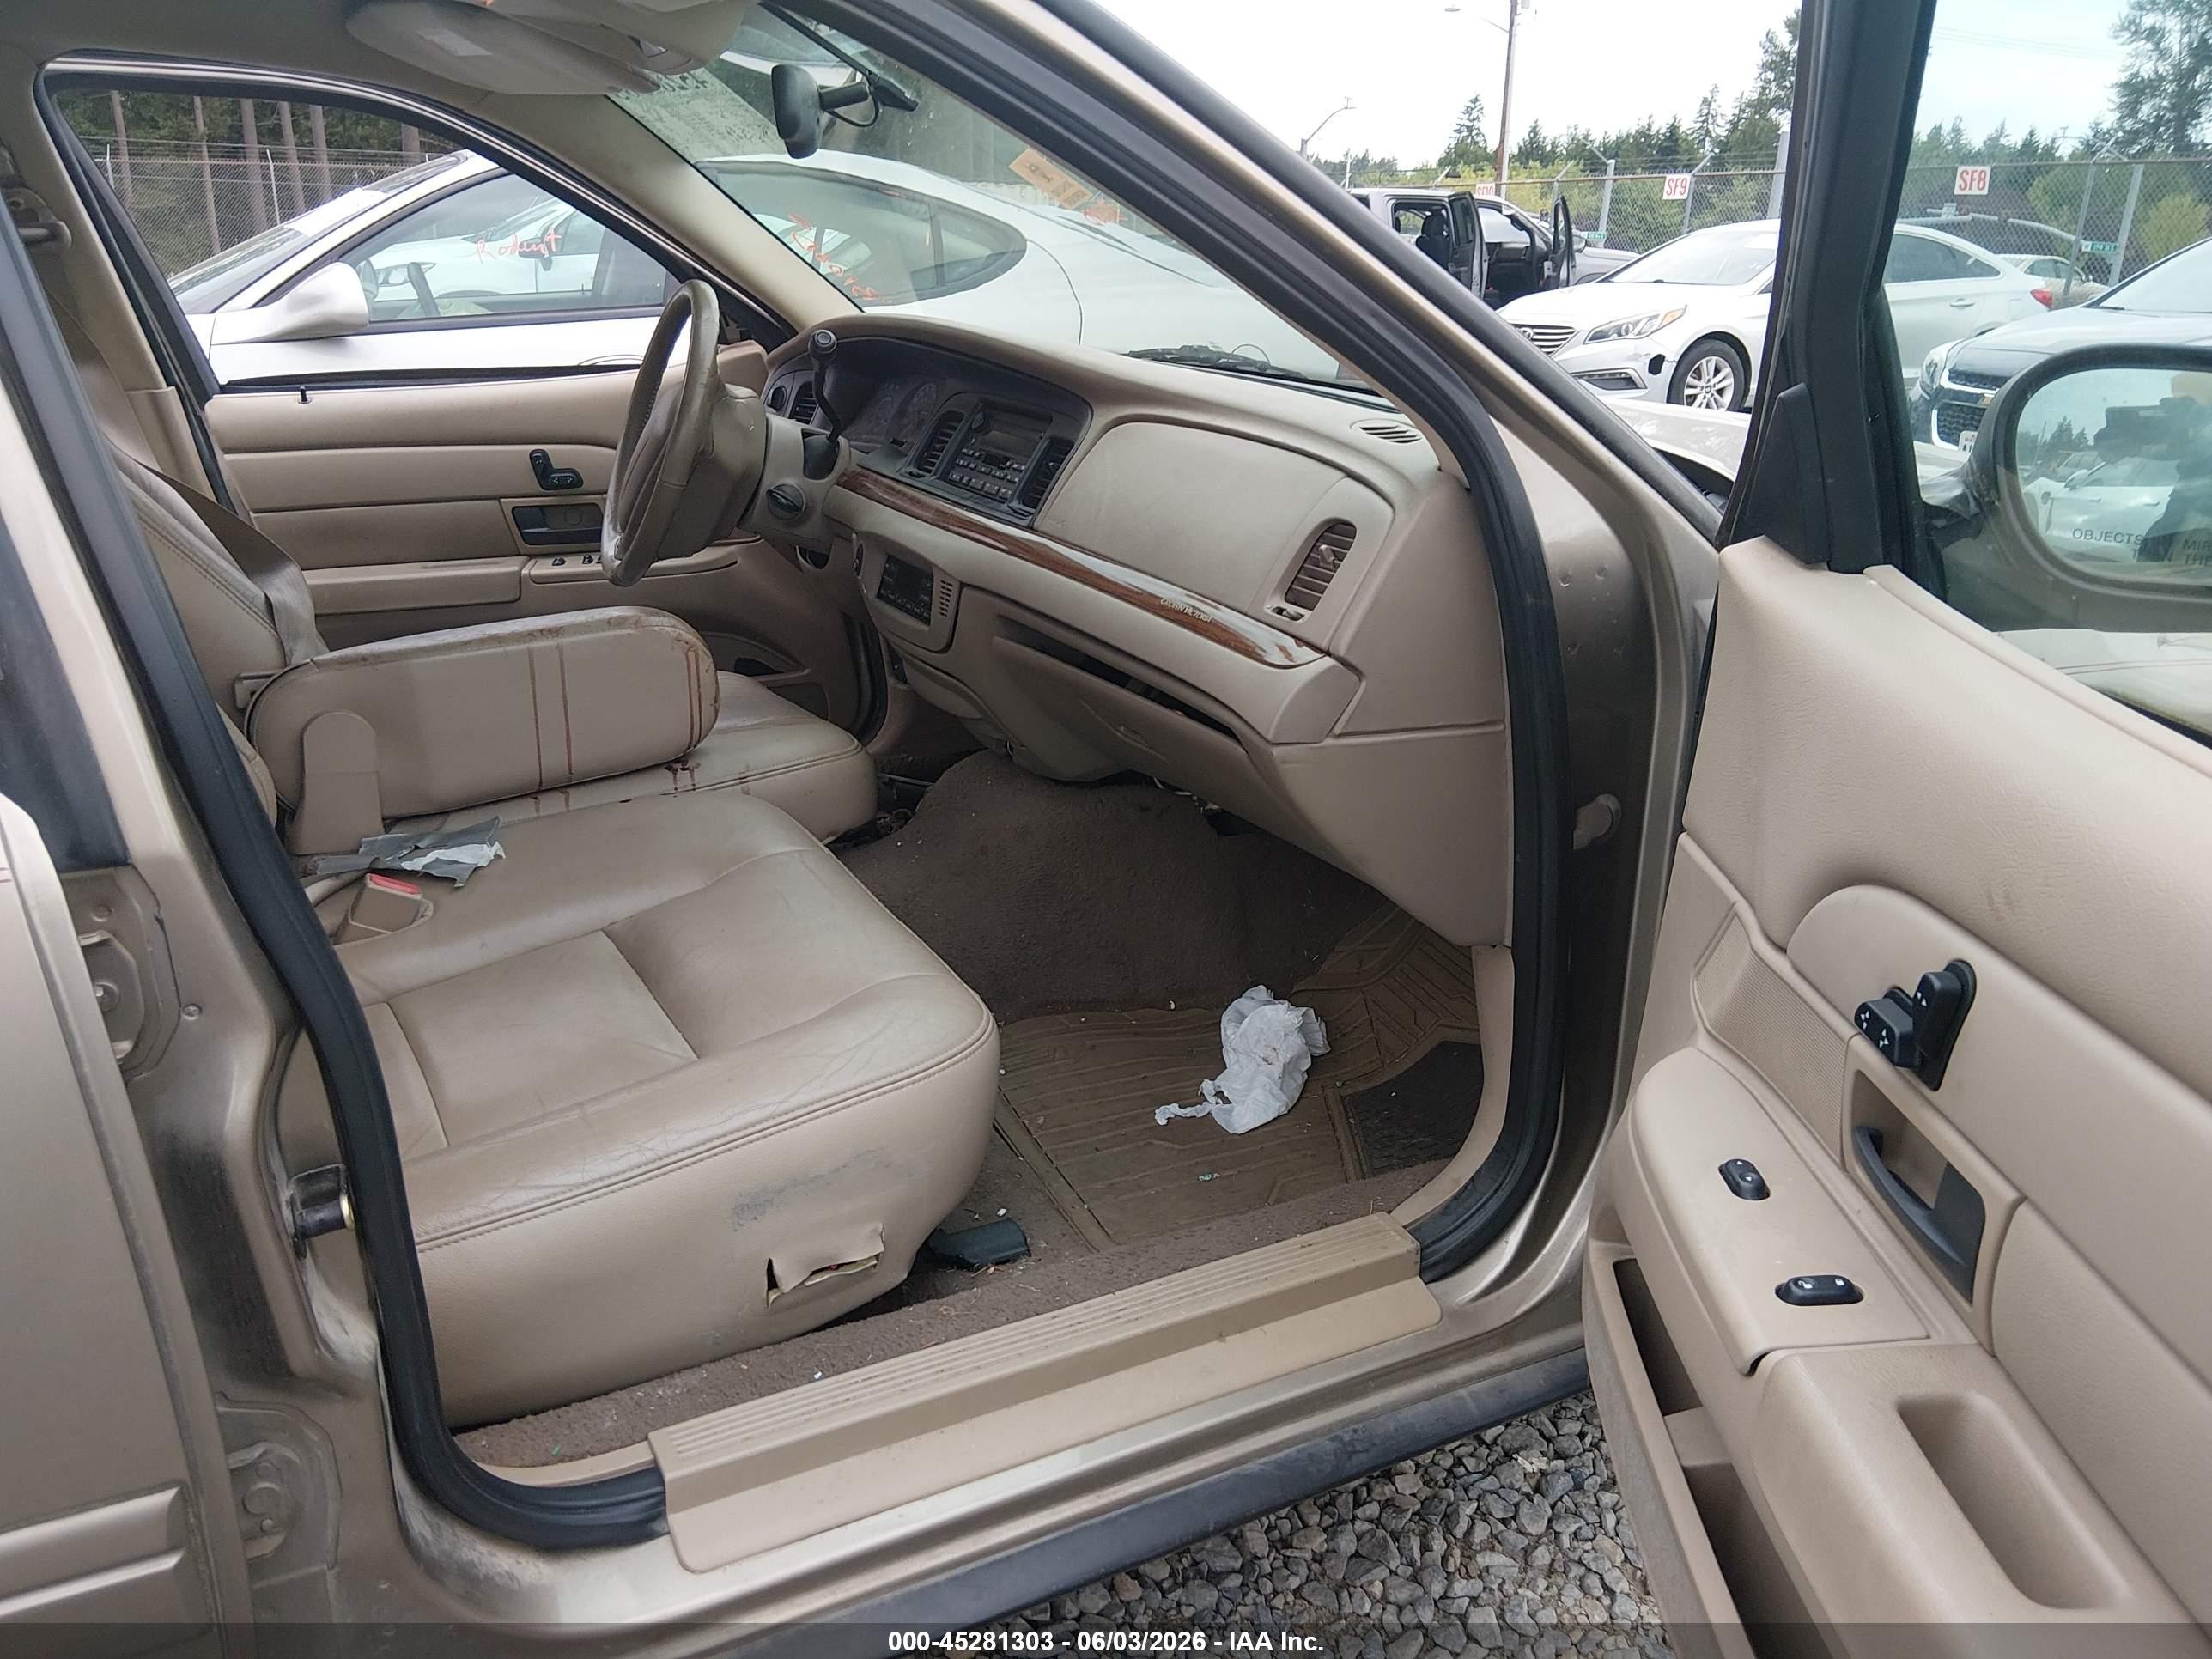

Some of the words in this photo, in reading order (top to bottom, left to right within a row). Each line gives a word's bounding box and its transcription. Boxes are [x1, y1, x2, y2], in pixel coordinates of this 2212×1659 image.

[1666, 177, 1688, 197] SF9
[1959, 169, 1987, 191] SF8
[2072, 528, 2144, 545] OBJECTS
